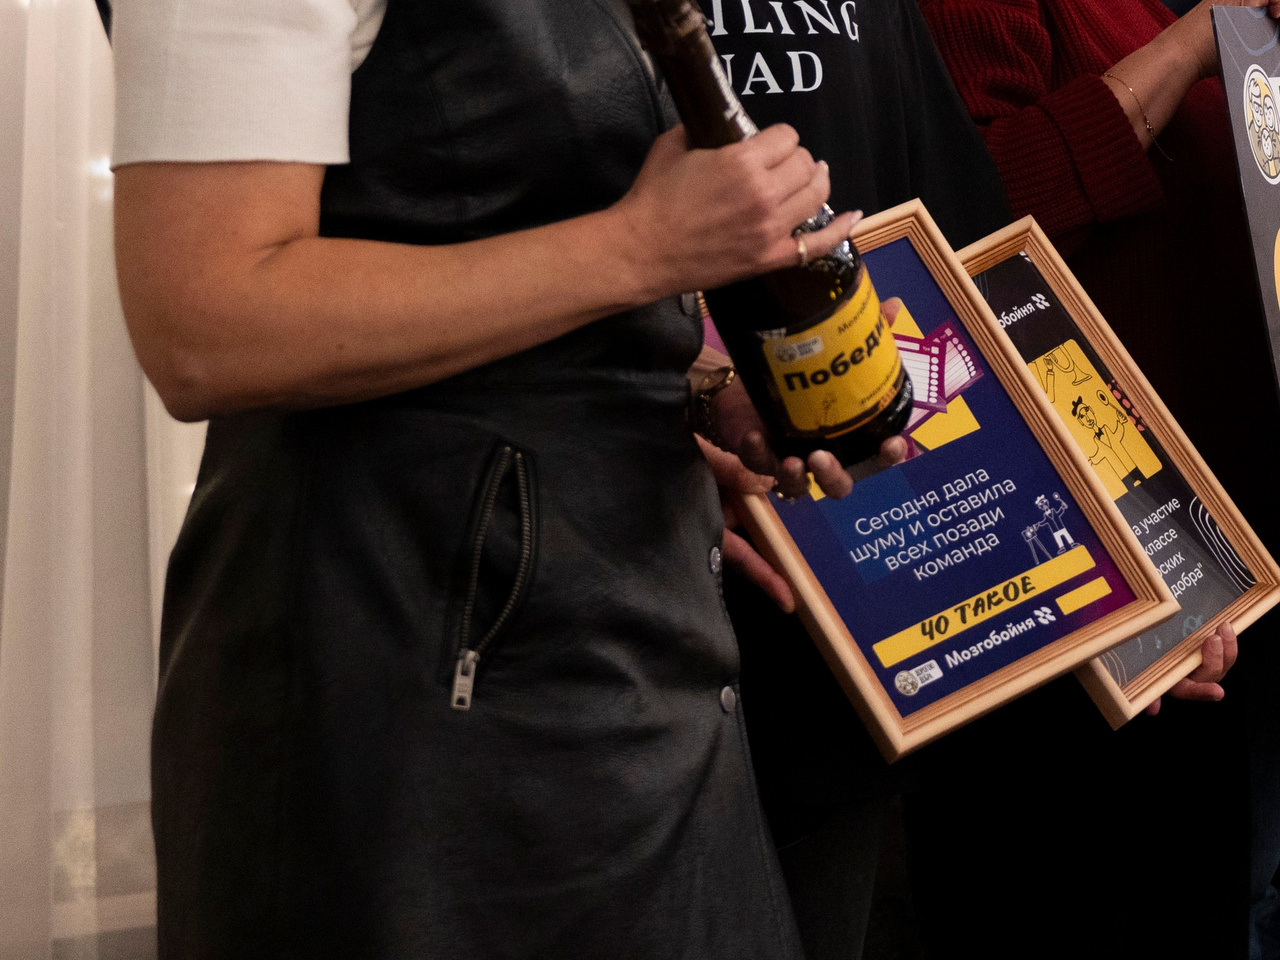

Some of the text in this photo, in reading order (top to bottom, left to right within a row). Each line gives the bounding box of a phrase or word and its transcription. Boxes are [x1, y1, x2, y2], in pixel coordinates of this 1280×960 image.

[998, 302, 1036, 329] обойня
[850, 479, 1017, 563] шуму и оставила
[855, 468, 990, 535] Сегодня дала
[1132, 497, 1181, 536] а участие
[885, 506, 1006, 571] всех позади
[913, 532, 1001, 581] команда
[1144, 528, 1178, 556] классе
[1156, 551, 1186, 577] ских
[1171, 562, 1204, 598] добра"
[954, 575, 1036, 624] ТАКОЕ
[944, 617, 1036, 669] Мозгобойня
